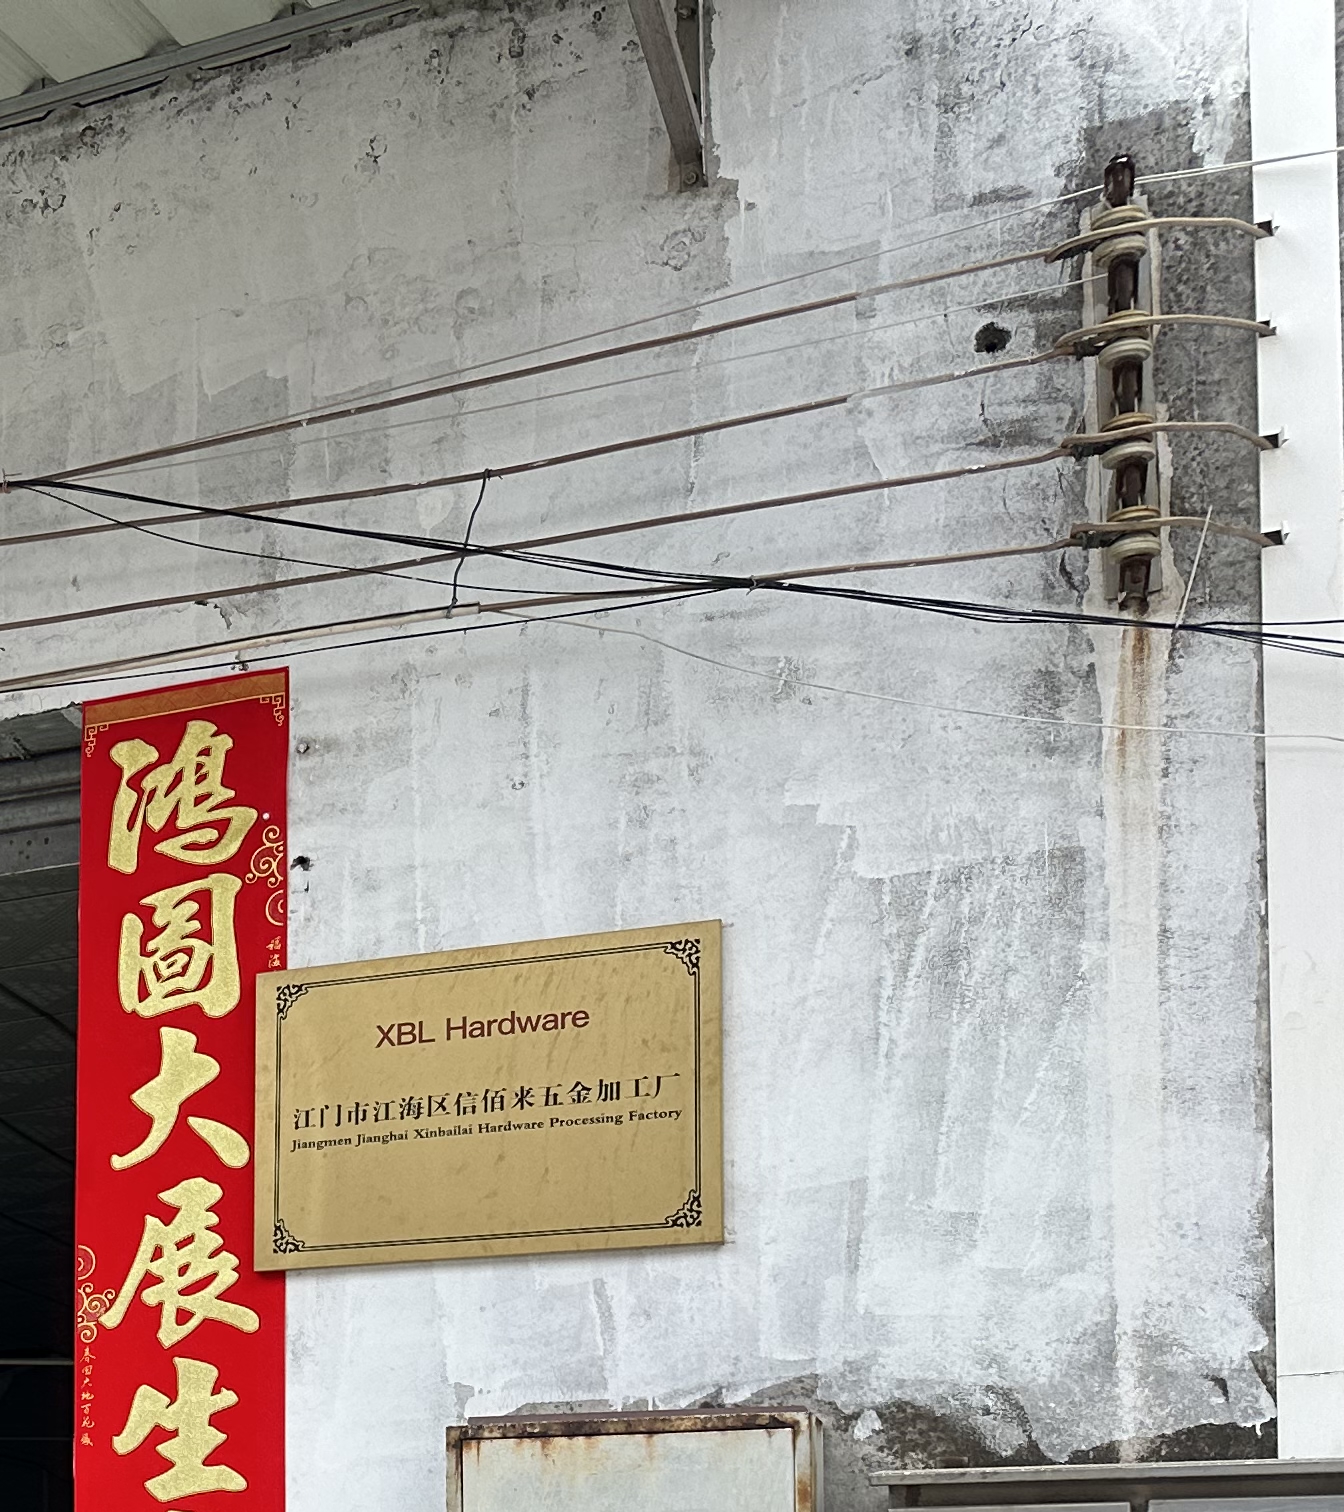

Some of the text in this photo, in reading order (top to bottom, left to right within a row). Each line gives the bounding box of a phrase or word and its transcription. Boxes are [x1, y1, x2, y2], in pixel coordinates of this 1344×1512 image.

[374, 1008, 591, 1049] XBL Hardware
[292, 1071, 682, 1131] 江门市江海区信佰来五金加工厂
[290, 1104, 683, 1153] Jiangmen Jianghai Xinbailai Hardware Processing Factory
